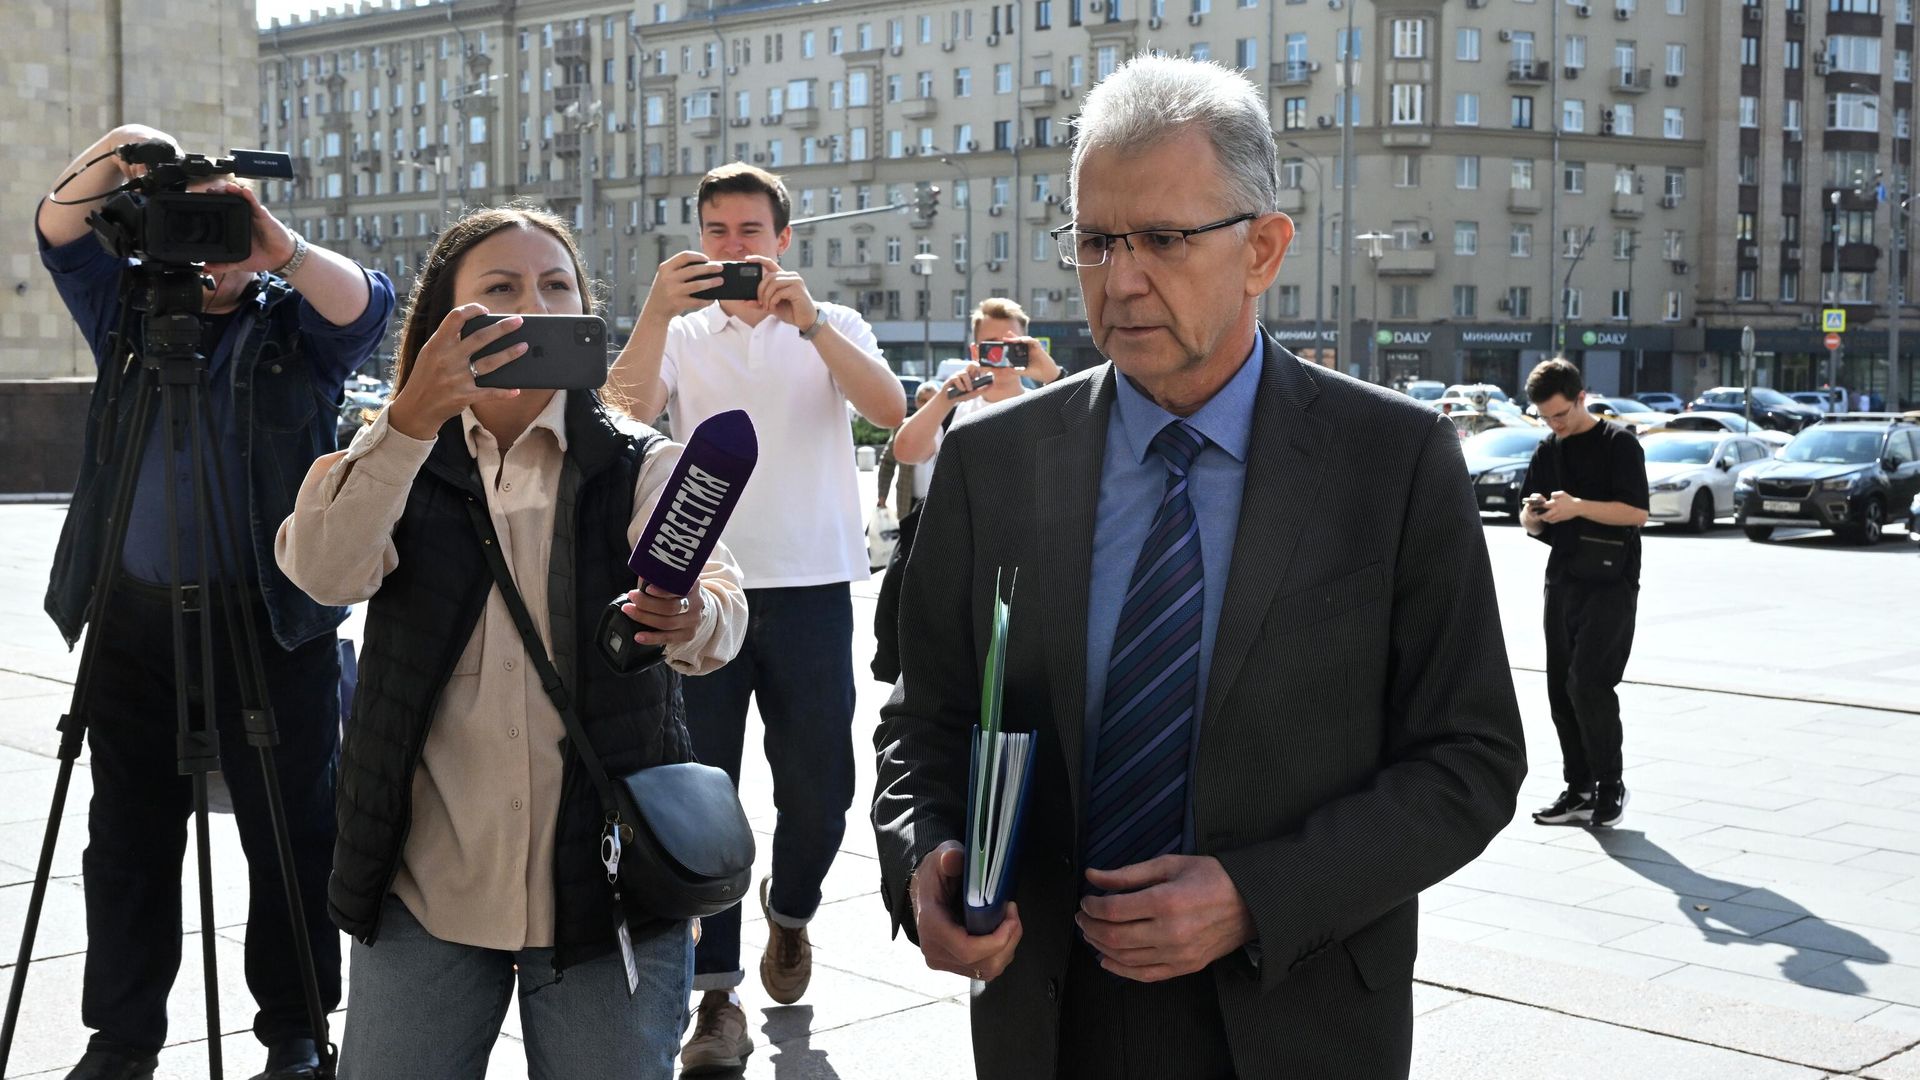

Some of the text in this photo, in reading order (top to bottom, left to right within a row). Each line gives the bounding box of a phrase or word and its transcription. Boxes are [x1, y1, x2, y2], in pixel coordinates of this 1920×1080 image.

[1393, 331, 1432, 344] DAILY
[1462, 331, 1533, 344] МИНИМАРКЕТ
[1597, 331, 1628, 345] DAILY
[648, 463, 731, 572] ИЗВЕСТИЯ
